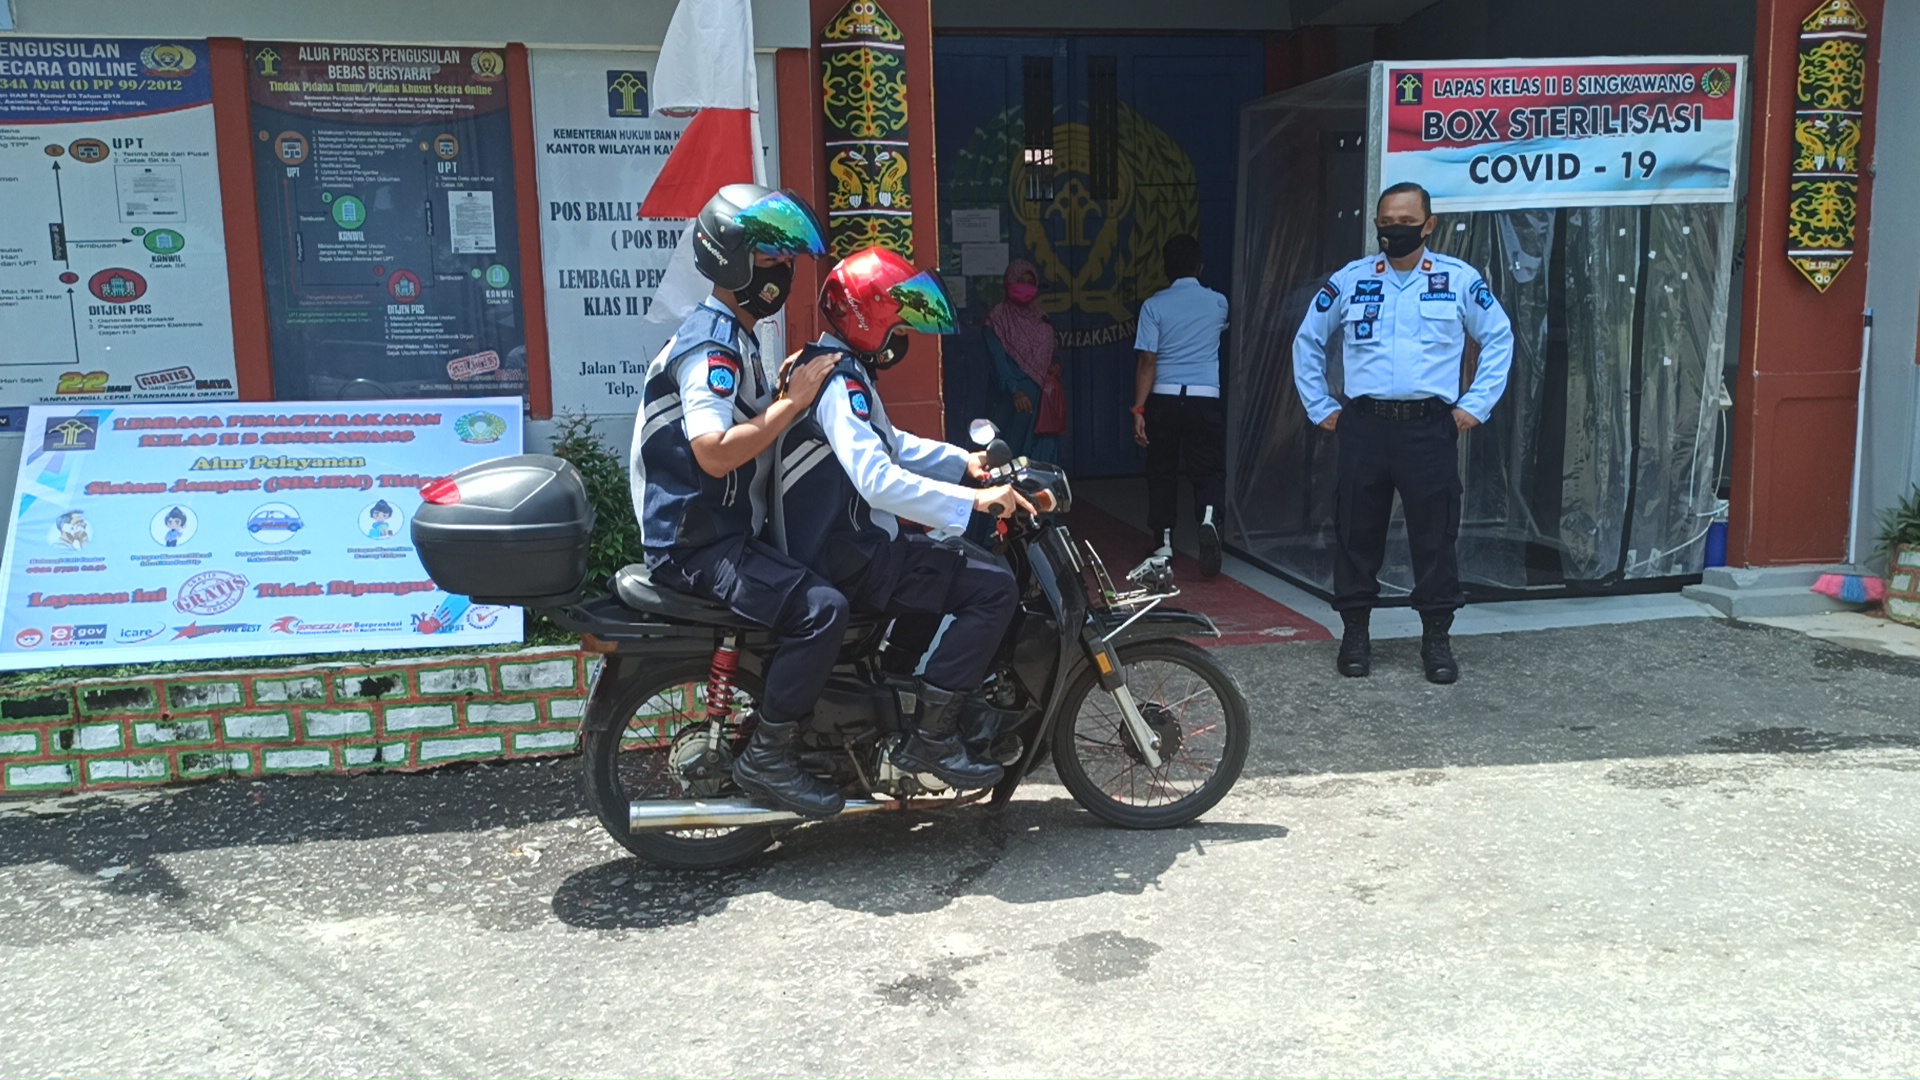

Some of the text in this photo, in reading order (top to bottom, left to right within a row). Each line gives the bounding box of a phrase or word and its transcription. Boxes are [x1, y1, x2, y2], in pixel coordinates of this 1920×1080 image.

[299, 46, 461, 64] ALUR PROSES PENGUSULAN
[68, 62, 138, 77] ONLINE
[328, 64, 433, 81] BEBAS BERSYARAT
[33, 80, 65, 91] Ayat
[69, 80, 89, 91] (1)
[93, 80, 114, 90] PP
[118, 80, 183, 91] 99/2012
[269, 81, 300, 91] Tindak
[302, 81, 334, 92] Pidana
[402, 83, 432, 94] Khusus
[433, 84, 463, 95] Secara
[464, 85, 493, 96] Online
[1433, 73, 1695, 98] LAPAS KELAS II B SINGKAWANG
[1422, 104, 1703, 141] BOX STERILISASI
[112, 137, 144, 149] UPT
[553, 128, 685, 141] KEMENTERIAN HUKUM DAN H
[546, 143, 597, 154] KANTOR
[599, 144, 651, 155] WILAYAH
[286, 167, 300, 178] UPT
[437, 161, 458, 173] UPT
[1468, 152, 1581, 184] COVID
[1621, 149, 1658, 179] 19
[549, 201, 582, 221] POS
[585, 202, 633, 221] BALAI
[621, 229, 653, 249] POS
[558, 269, 632, 289] LEMBAGA
[88, 304, 152, 316] DITJEN PAS
[583, 297, 621, 316] KLAS
[625, 297, 639, 316] II
[1055, 319, 1137, 348] YARAKATAN
[578, 361, 616, 376] Jalan
[56, 371, 109, 395] 22
[142, 370, 188, 386] GRATIS
[604, 381, 639, 398] Telp.
[113, 413, 442, 431] LEMBAGA PEMASYARAKATAN
[138, 433, 217, 447] KELAS
[260, 431, 416, 445] SINGKAWANG
[188, 455, 366, 472] Alur Pelayanan
[84, 481, 167, 496] Sistem
[27, 575, 436, 612] Layanan Ini GRATIS Tidak Dipungut
[78, 626, 104, 639] gov
[120, 628, 153, 639] icare
[243, 624, 262, 633] BEST
